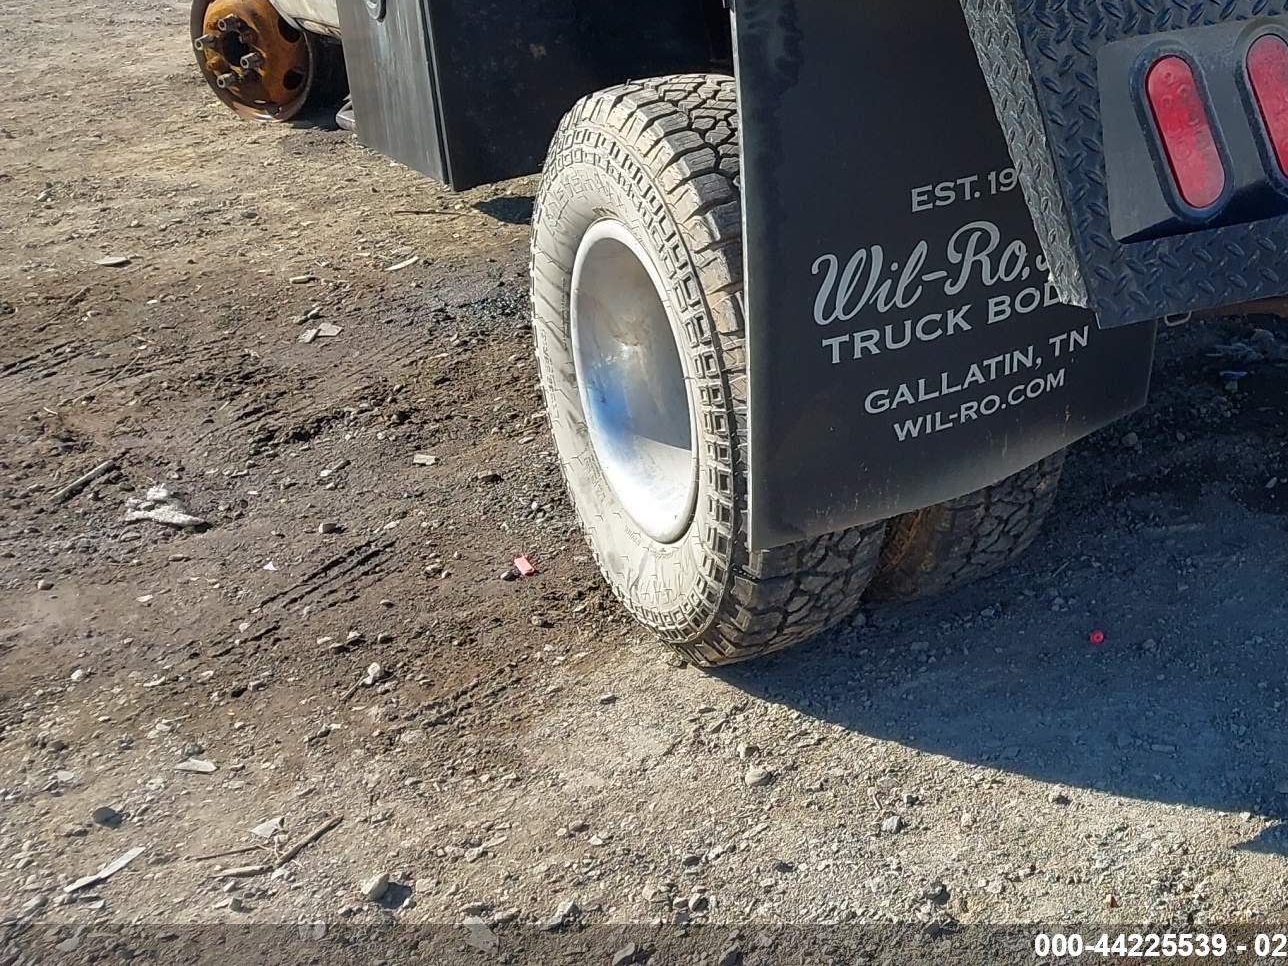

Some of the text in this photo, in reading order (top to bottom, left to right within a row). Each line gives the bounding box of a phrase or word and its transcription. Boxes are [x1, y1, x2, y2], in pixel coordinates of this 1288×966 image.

[911, 167, 1018, 212] EST. 19
[821, 281, 1061, 365] TRUCK BOD
[863, 326, 1090, 415] GALLATIN, TN
[893, 368, 1066, 442] WIL-RO.COM
